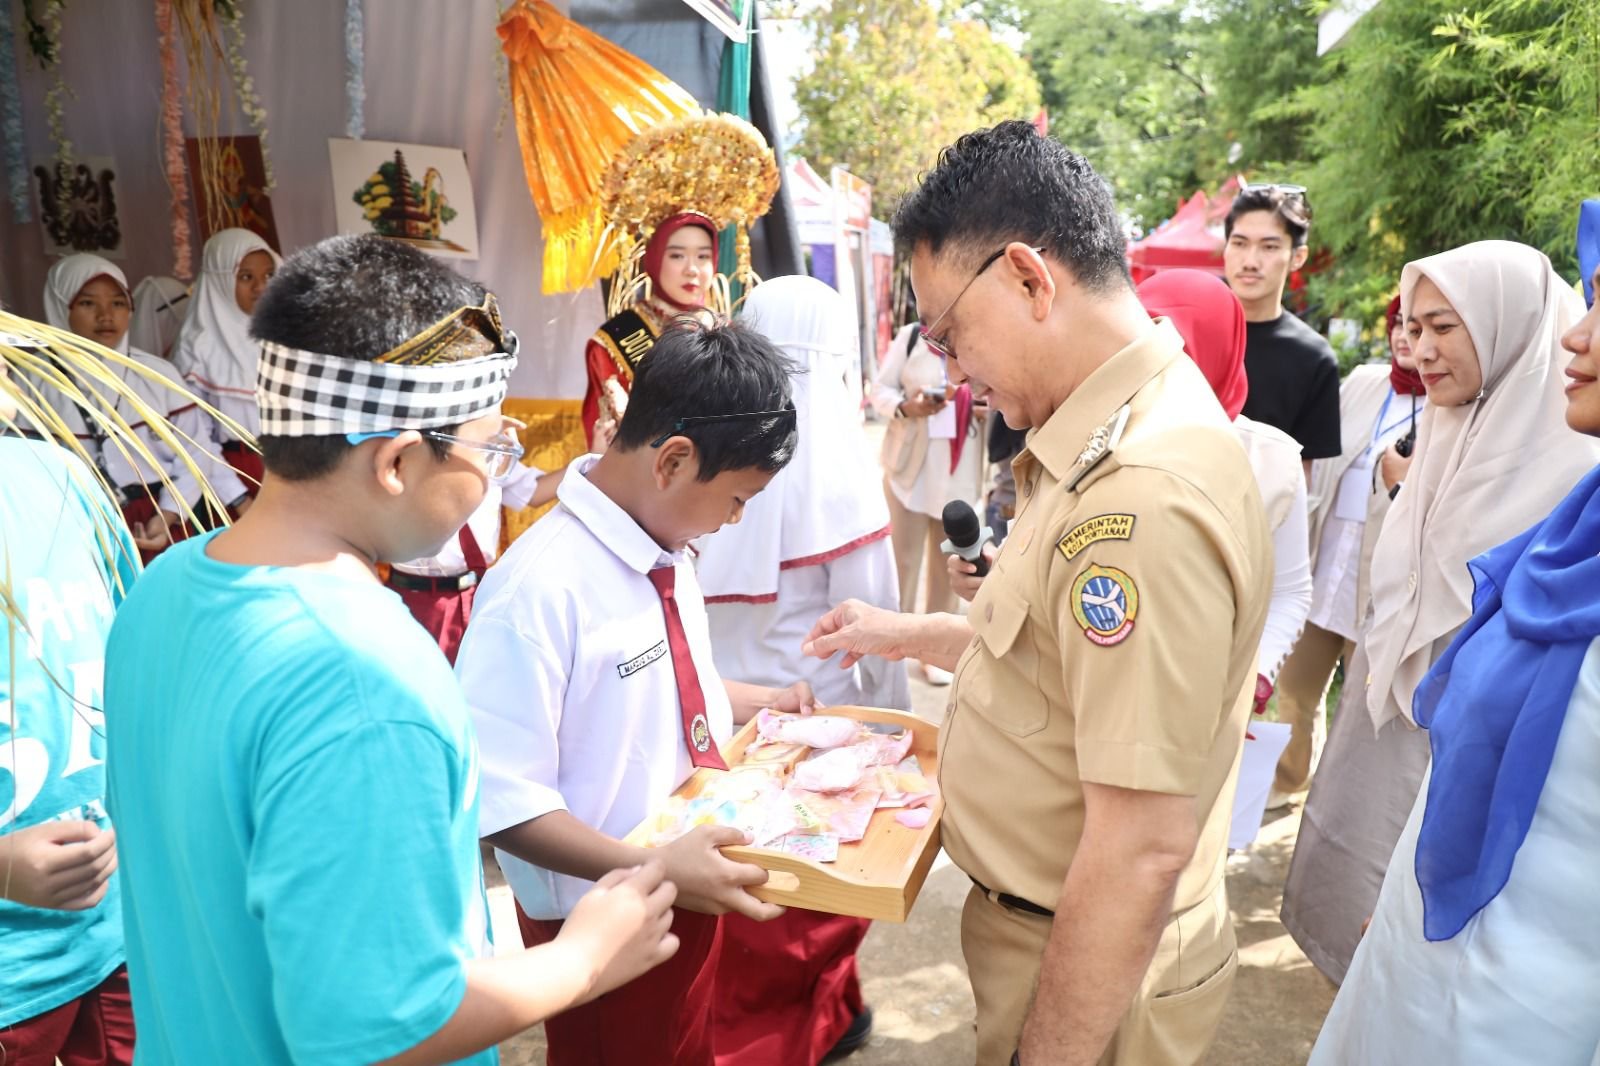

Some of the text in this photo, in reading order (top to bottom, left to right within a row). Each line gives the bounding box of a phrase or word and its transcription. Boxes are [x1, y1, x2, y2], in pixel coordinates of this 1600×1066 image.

[1061, 517, 1129, 548] PEMERINTAH
[1067, 527, 1127, 556] KOTA PONTIANAK
